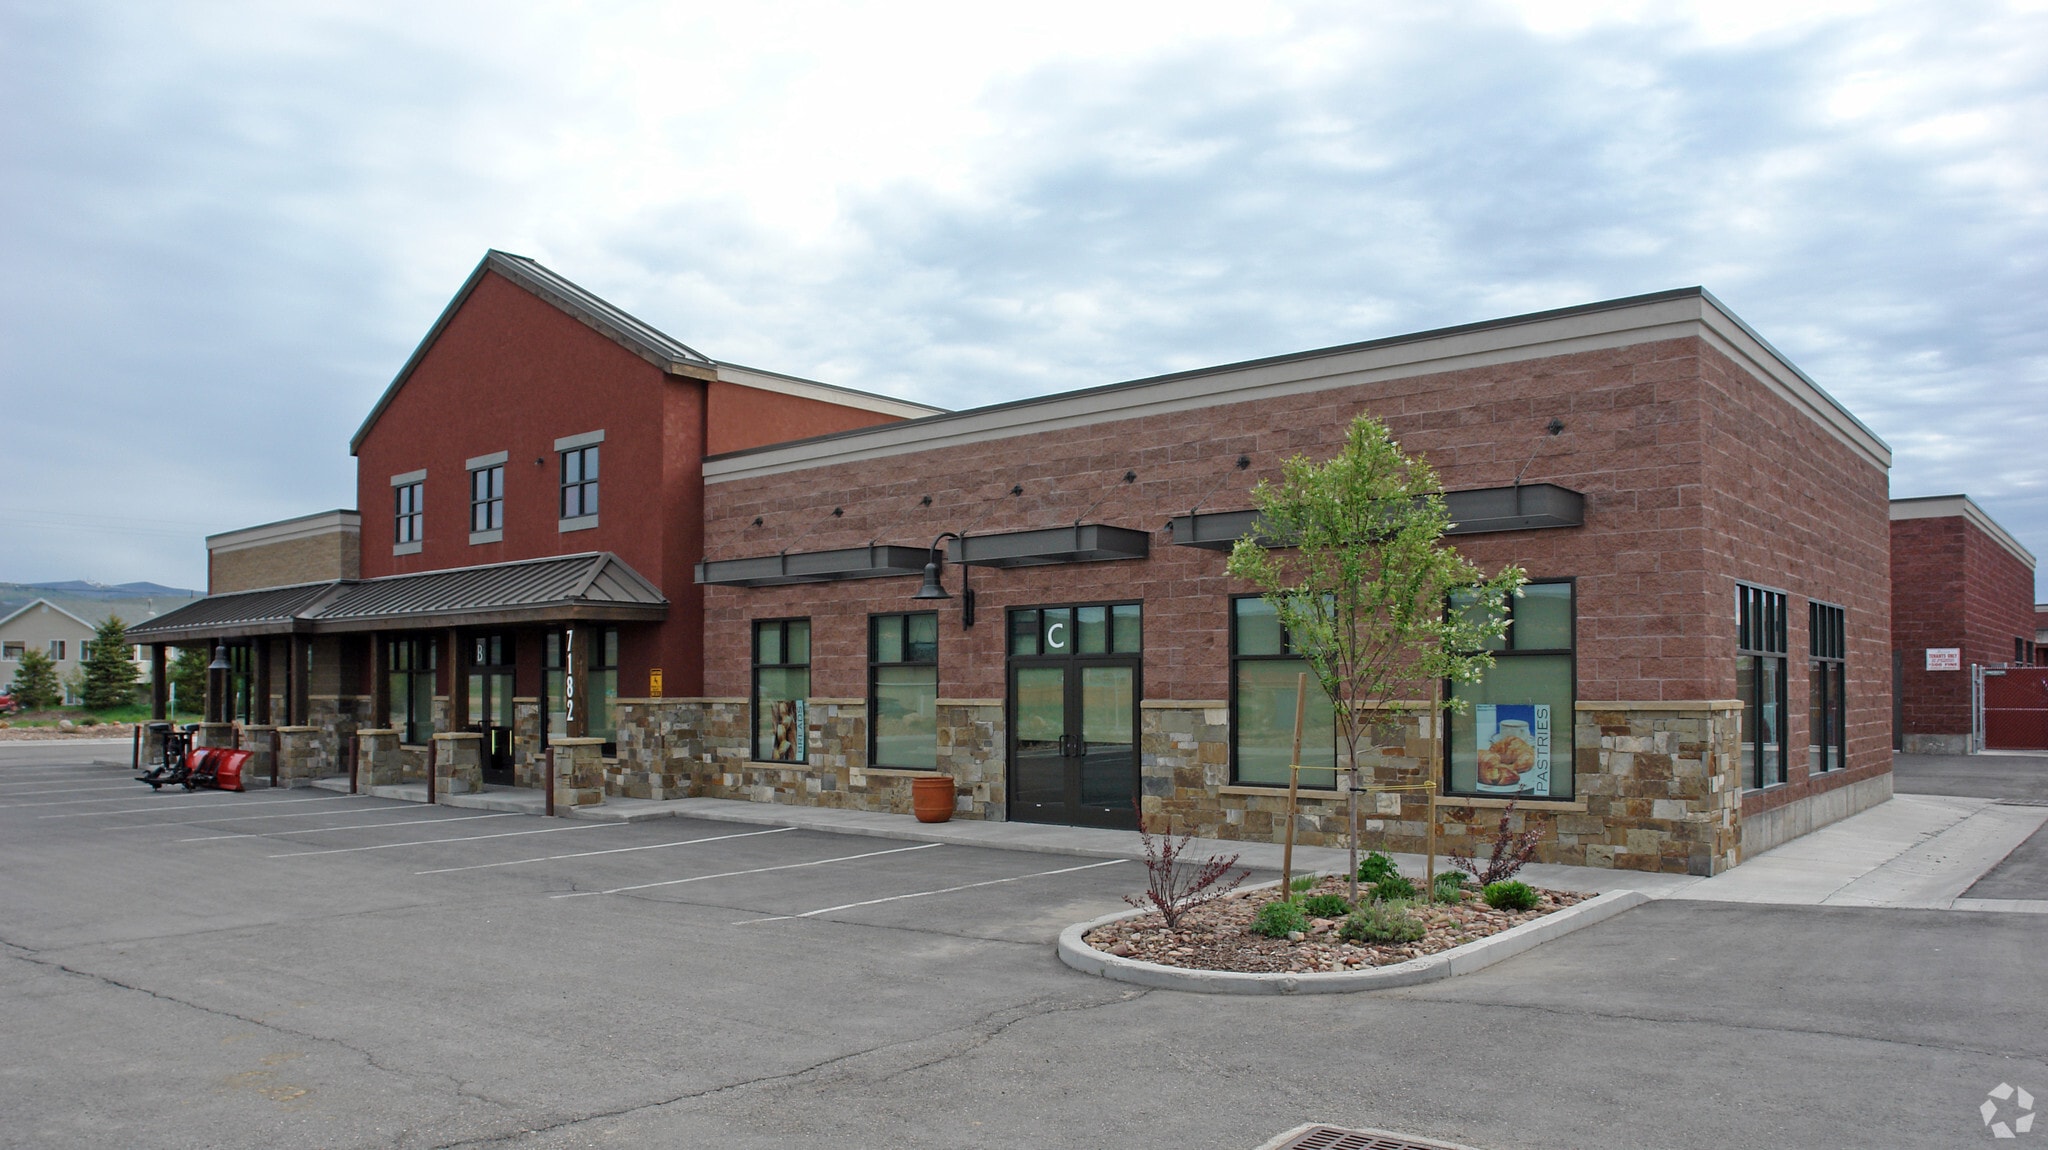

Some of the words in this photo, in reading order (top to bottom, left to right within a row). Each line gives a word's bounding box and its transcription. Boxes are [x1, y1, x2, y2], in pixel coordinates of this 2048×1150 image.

[476, 644, 483, 662] B
[1047, 623, 1065, 649] C
[566, 629, 574, 721] 7182
[1536, 708, 1548, 792] PASTRIES
